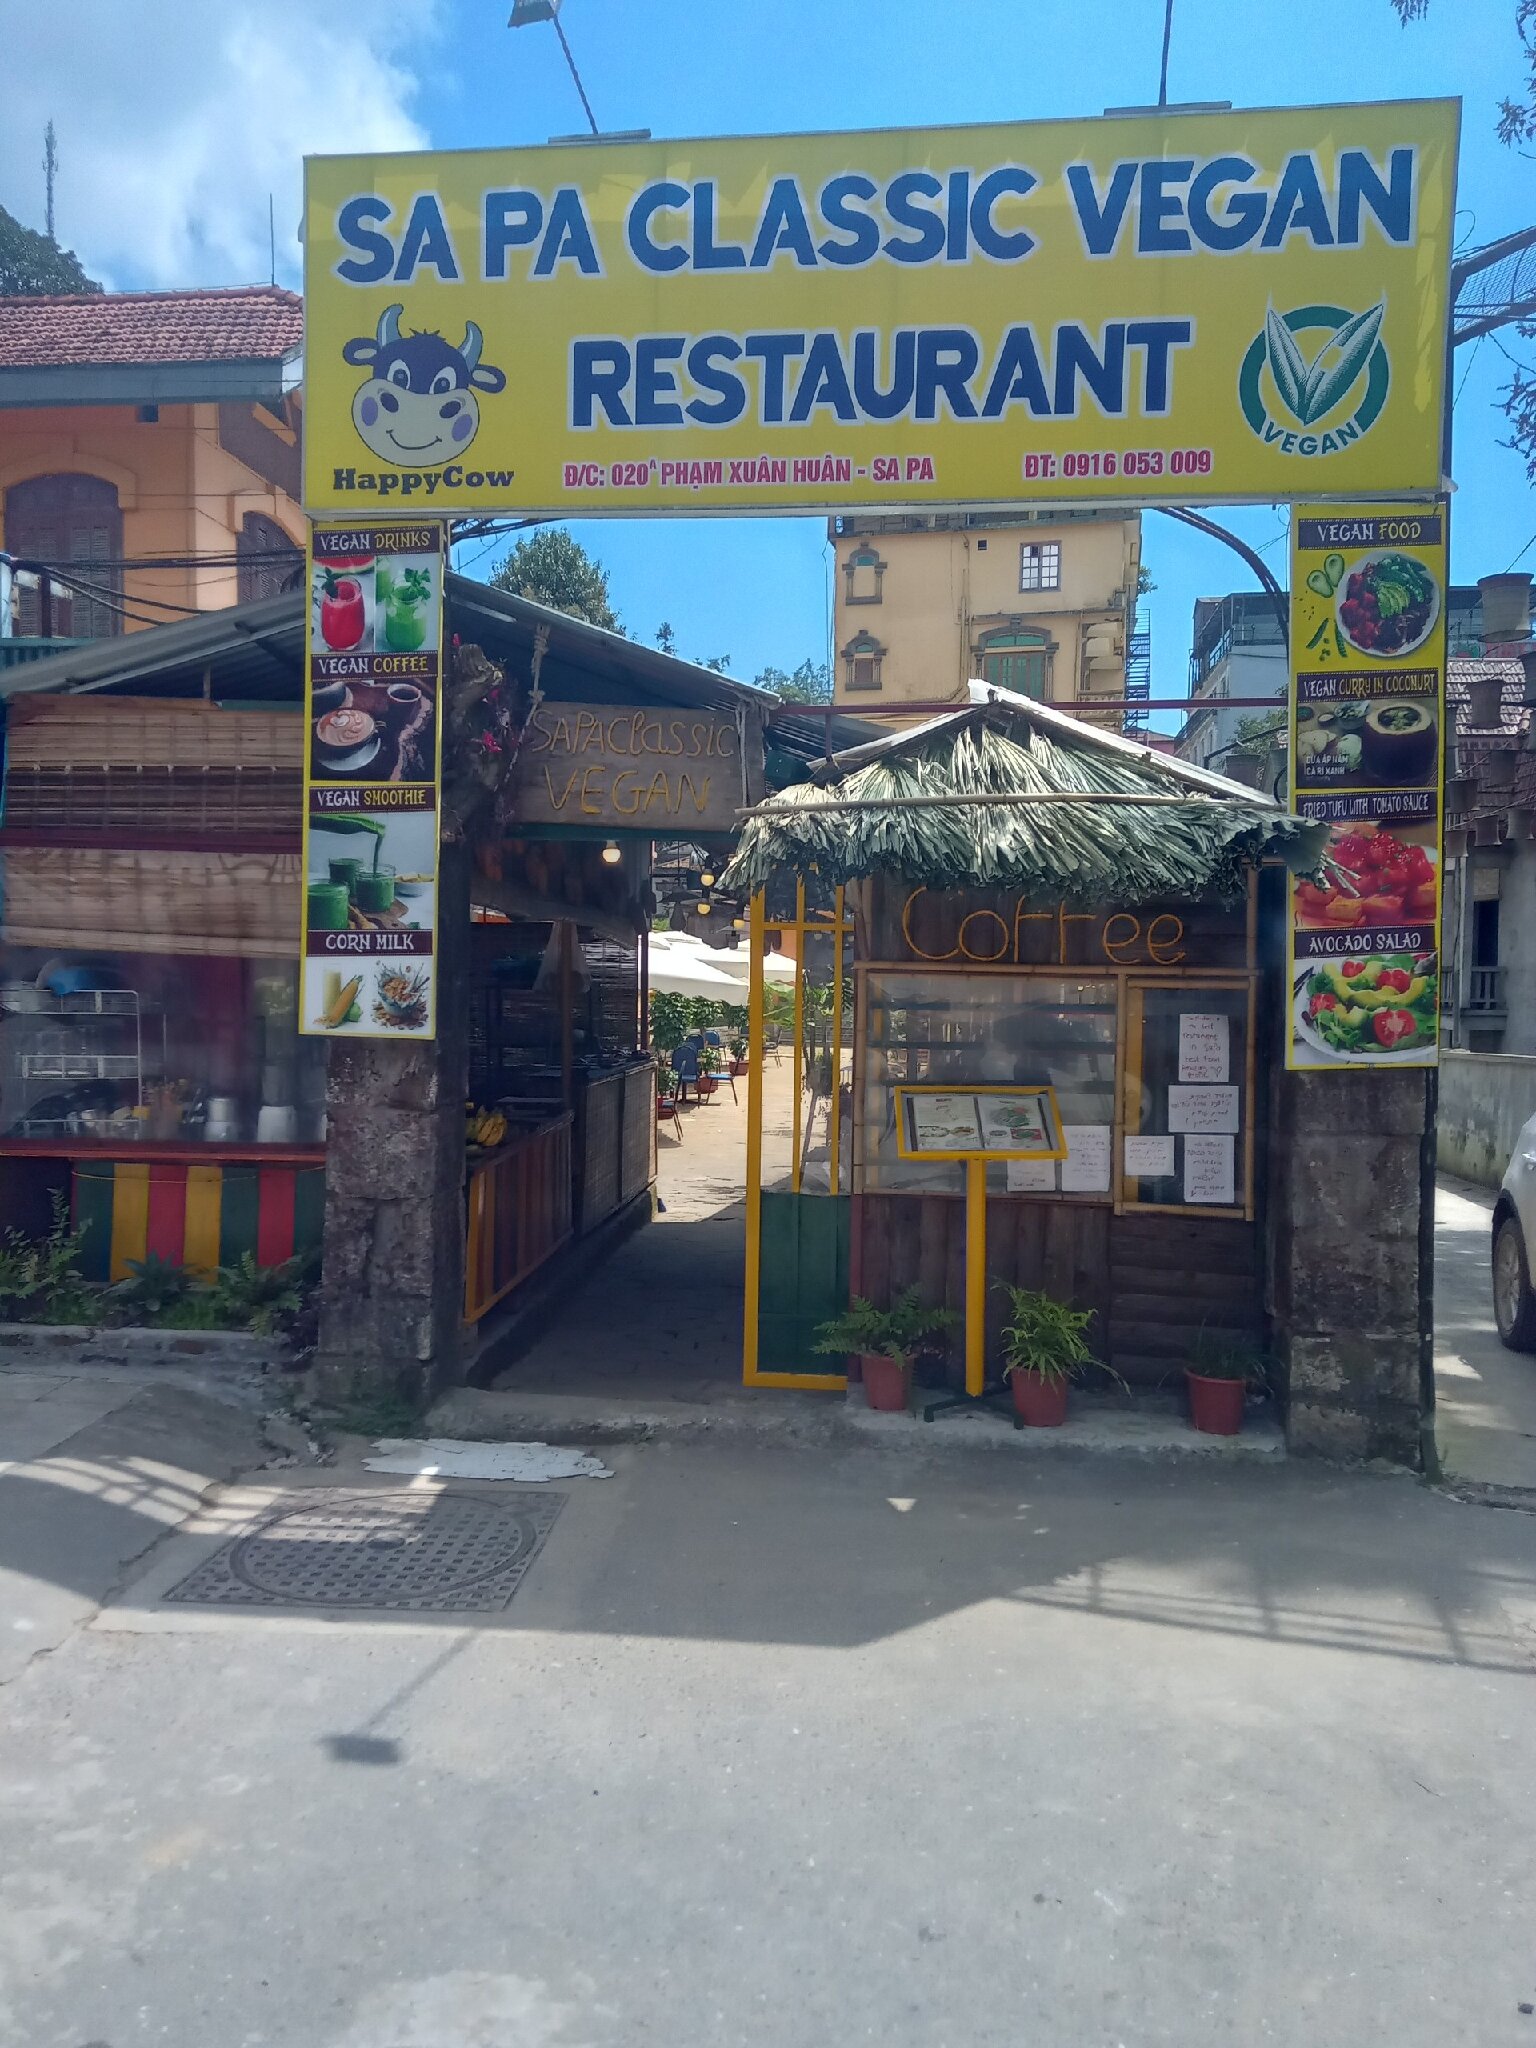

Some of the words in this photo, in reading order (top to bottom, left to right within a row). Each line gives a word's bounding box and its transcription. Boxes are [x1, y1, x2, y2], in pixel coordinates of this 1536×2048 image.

[337, 194, 459, 283] SA
[485, 189, 600, 277] PA
[628, 168, 1037, 273] CLASSIC
[1067, 149, 1413, 254] VEGAN
[572, 321, 1191, 428] RESTAURANT
[1264, 421, 1359, 456] VEGAN
[564, 464, 605, 486] Đ/C:
[661, 461, 722, 490] PHẠM
[729, 455, 787, 484] XUÂN
[793, 454, 851, 483] HUÂN
[873, 458, 899, 482] SA
[906, 457, 934, 481] PA
[1025, 453, 1056, 479] ĐT:
[1063, 452, 1116, 477] 0916
[1124, 451, 1163, 475] 053
[1170, 449, 1211, 474] 009
[333, 466, 515, 495] HappyCow
[320, 533, 370, 551] VEGAN
[374, 530, 431, 551] DRINKS
[1317, 524, 1374, 542] VEGAN
[1379, 521, 1421, 540] FOOD
[319, 657, 369, 674] VEGAN
[373, 656, 429, 673] COFFEE
[1304, 679, 1337, 697] VEGAN
[1374, 677, 1383, 694] IN
[317, 790, 360, 807] VEGAN
[363, 789, 426, 806] SMOOTHIE
[544, 764, 711, 815] VEGAN
[1303, 802, 1327, 819] FRIED
[1372, 796, 1401, 814] TOMATO
[1403, 793, 1429, 811] SAUCE
[902, 886, 1187, 965] Coffee
[325, 934, 370, 952] CORN
[375, 933, 415, 951] MILK
[1309, 933, 1372, 954] AVOCADO
[1375, 932, 1421, 950] SALAD
